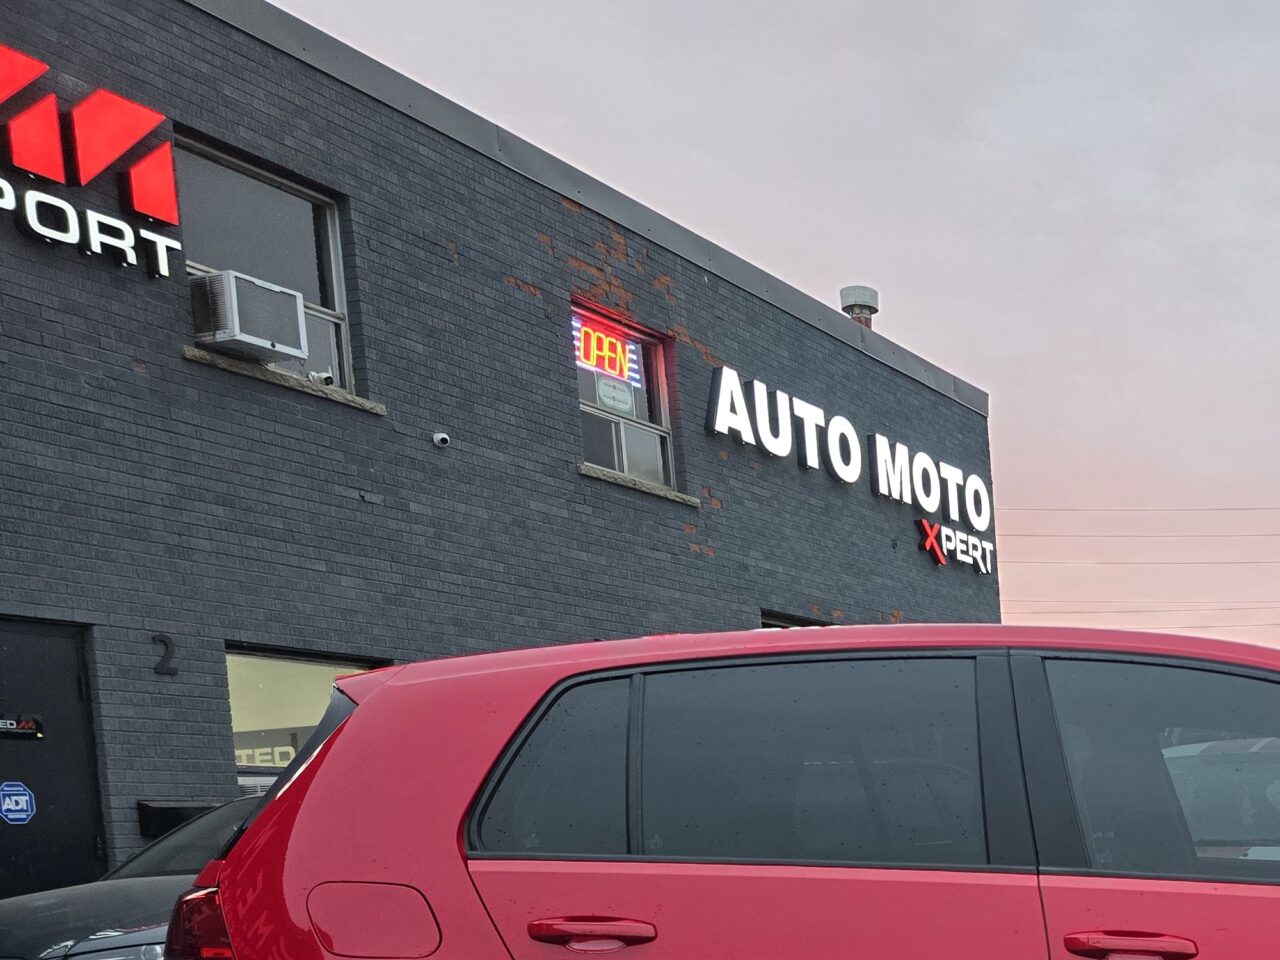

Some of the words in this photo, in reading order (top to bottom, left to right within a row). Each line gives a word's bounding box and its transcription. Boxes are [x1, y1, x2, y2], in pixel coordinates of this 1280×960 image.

[581, 327, 629, 380] OPEN
[714, 366, 862, 483] AUTO
[875, 432, 991, 532] MOTO
[921, 518, 994, 574] XPERT
[151, 634, 178, 676] 2
[4, 796, 29, 811] ADT
